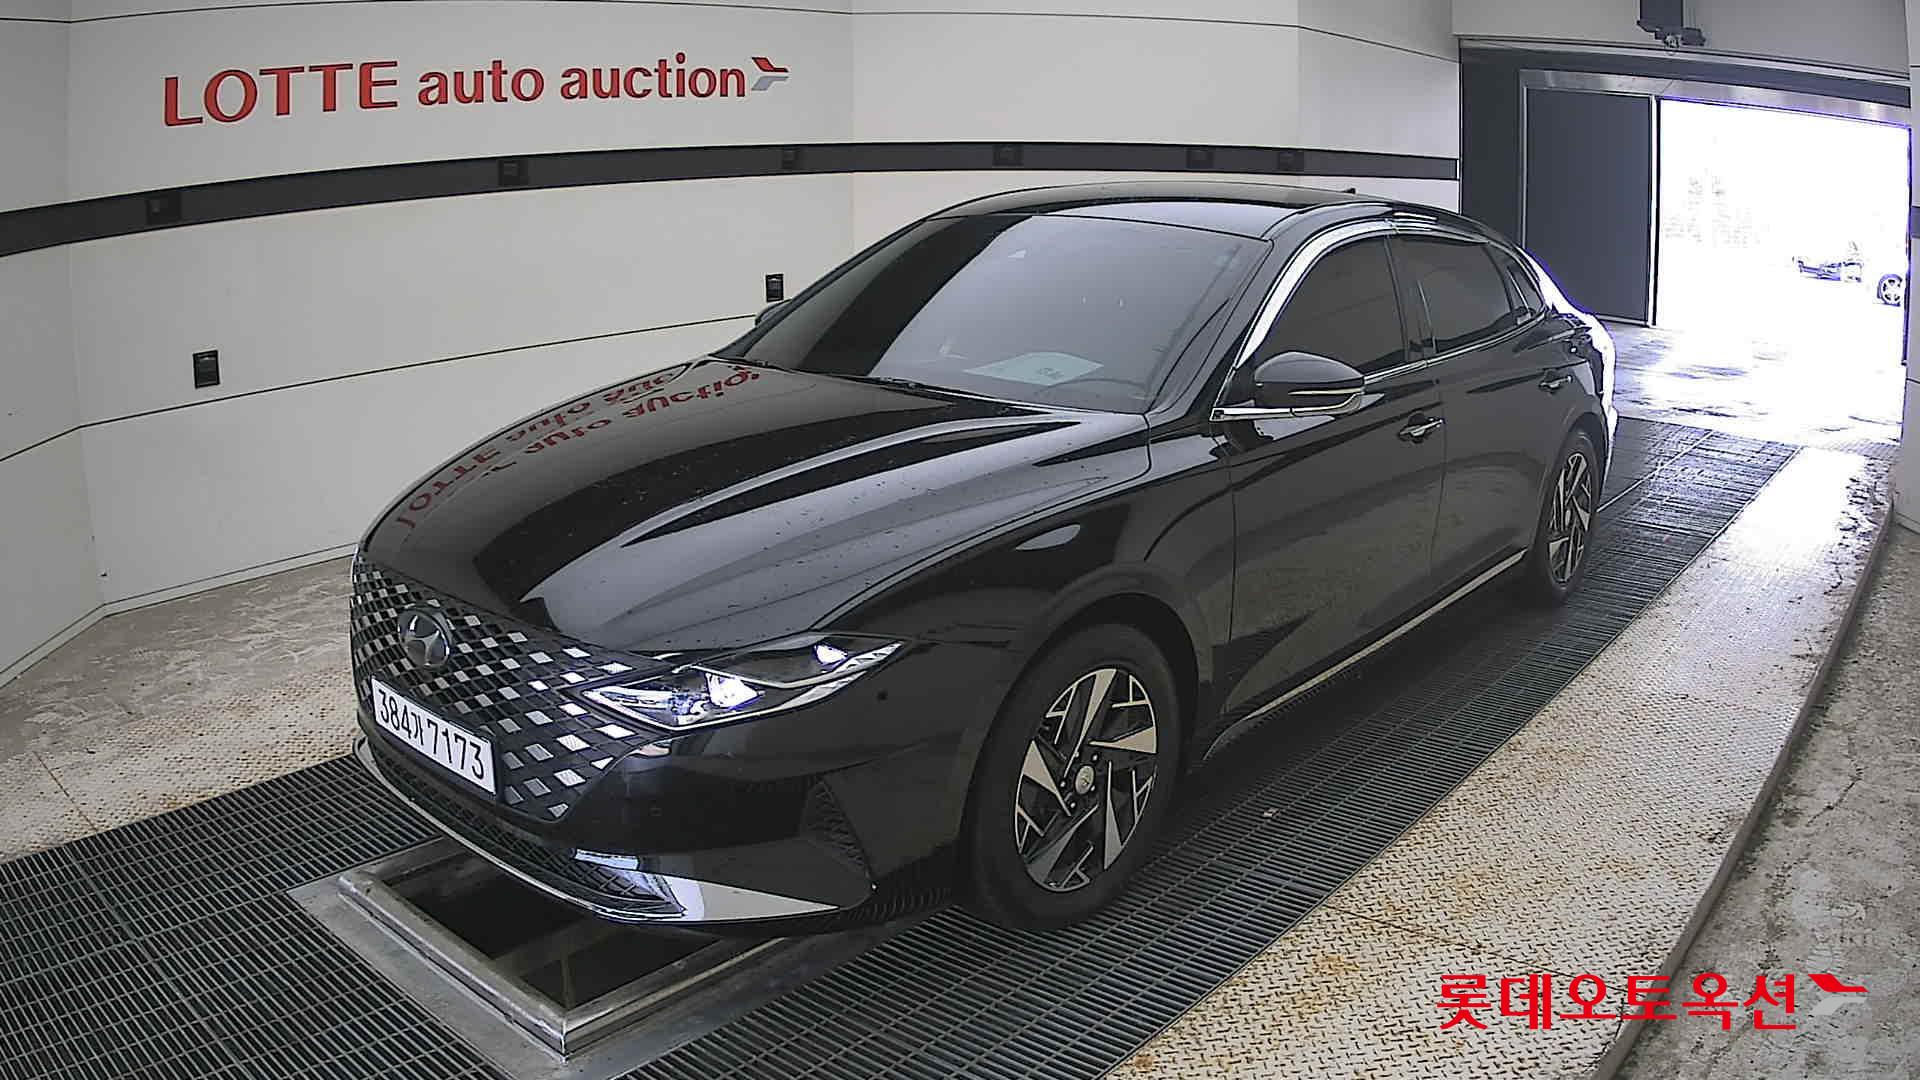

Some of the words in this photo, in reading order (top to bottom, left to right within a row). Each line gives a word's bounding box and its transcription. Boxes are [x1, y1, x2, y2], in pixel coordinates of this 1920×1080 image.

[163, 60, 399, 127] LOTTE
[416, 59, 545, 106] auto
[559, 52, 748, 101] auction
[378, 688, 425, 746] 384가
[426, 718, 485, 780] 7173
